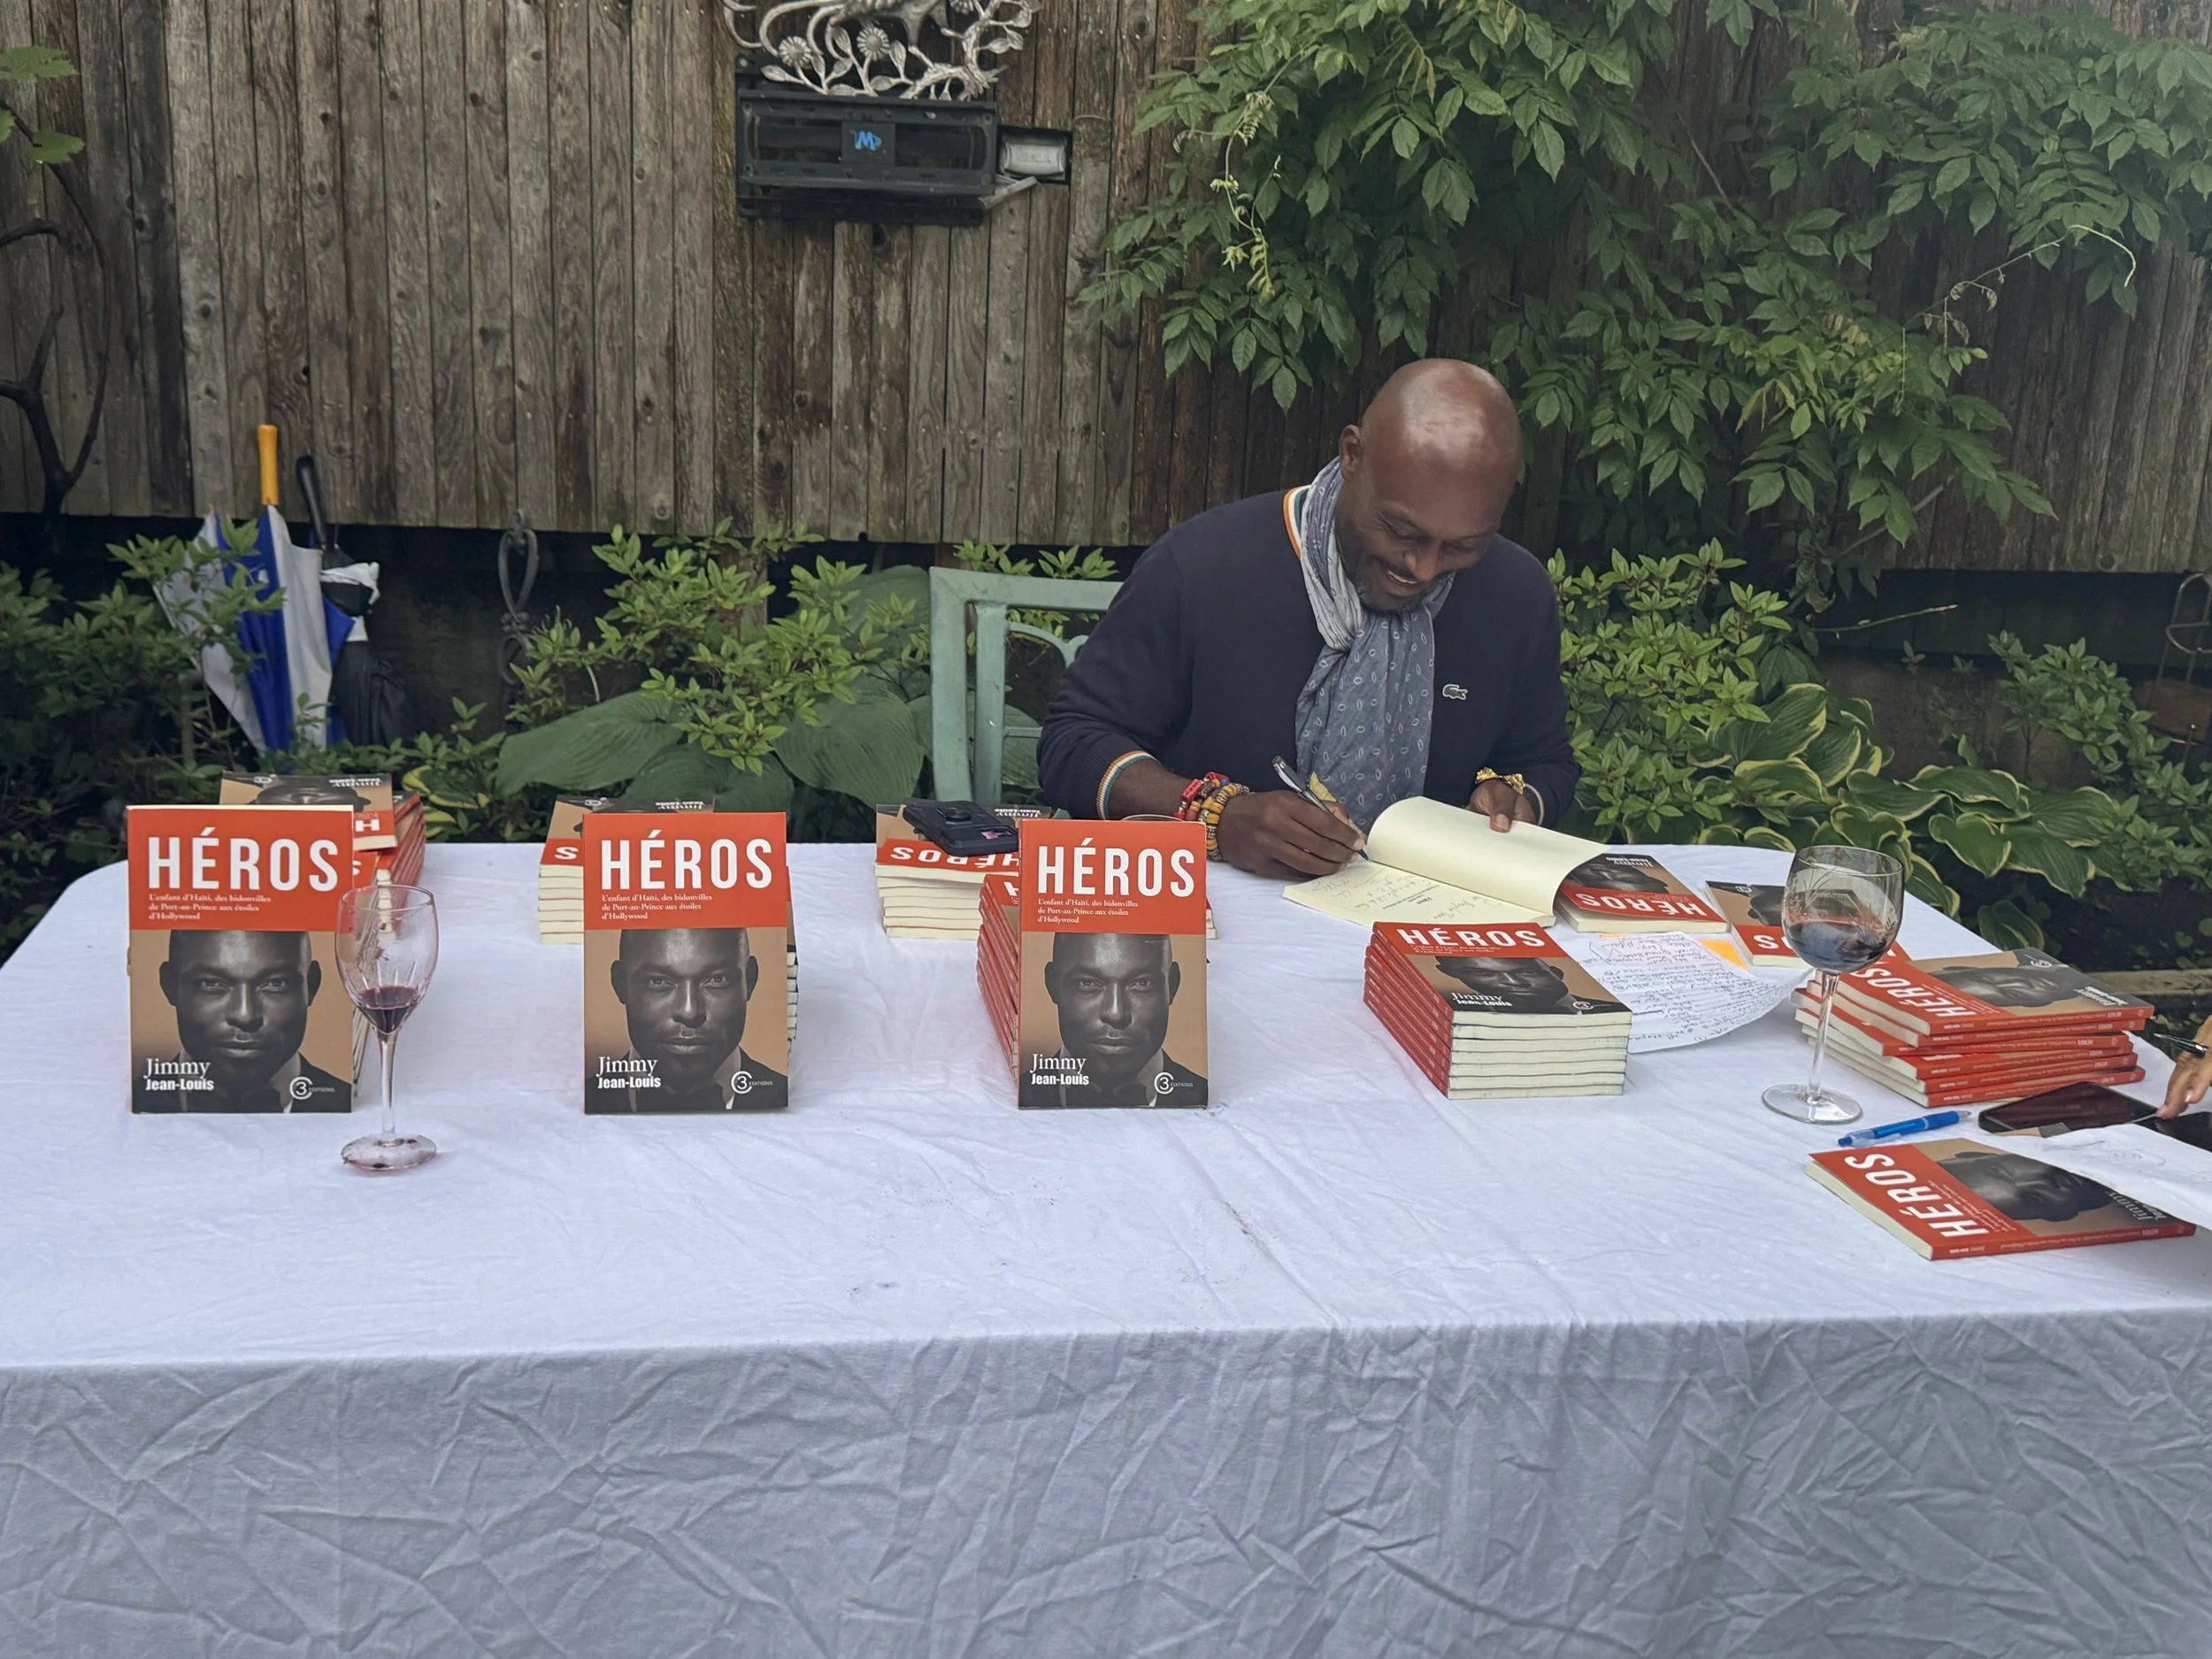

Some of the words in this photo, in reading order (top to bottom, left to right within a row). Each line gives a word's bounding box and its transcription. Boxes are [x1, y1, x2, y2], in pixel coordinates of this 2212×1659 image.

[149, 826, 339, 892] HÉROS
[602, 829, 772, 889] HÉROS
[1038, 837, 1194, 897] HÉROS
[161, 902, 218, 911] Port-au-Prince
[1575, 893, 1708, 916] HÉROS
[1396, 927, 1546, 947] HÉROS
[1451, 992, 1502, 1002] Jimmy
[1849, 968, 1978, 1018] HÉROS
[143, 1058, 211, 1079] Jimmy
[595, 1056, 658, 1077] Jimmy
[1029, 1053, 1087, 1074] Jimmy
[145, 1079, 214, 1091] Jean-Louis
[597, 1076, 662, 1089] Jean-Louis
[1031, 1072, 1089, 1086] Jean-Louis
[1844, 1153, 1990, 1238] HÉROS
